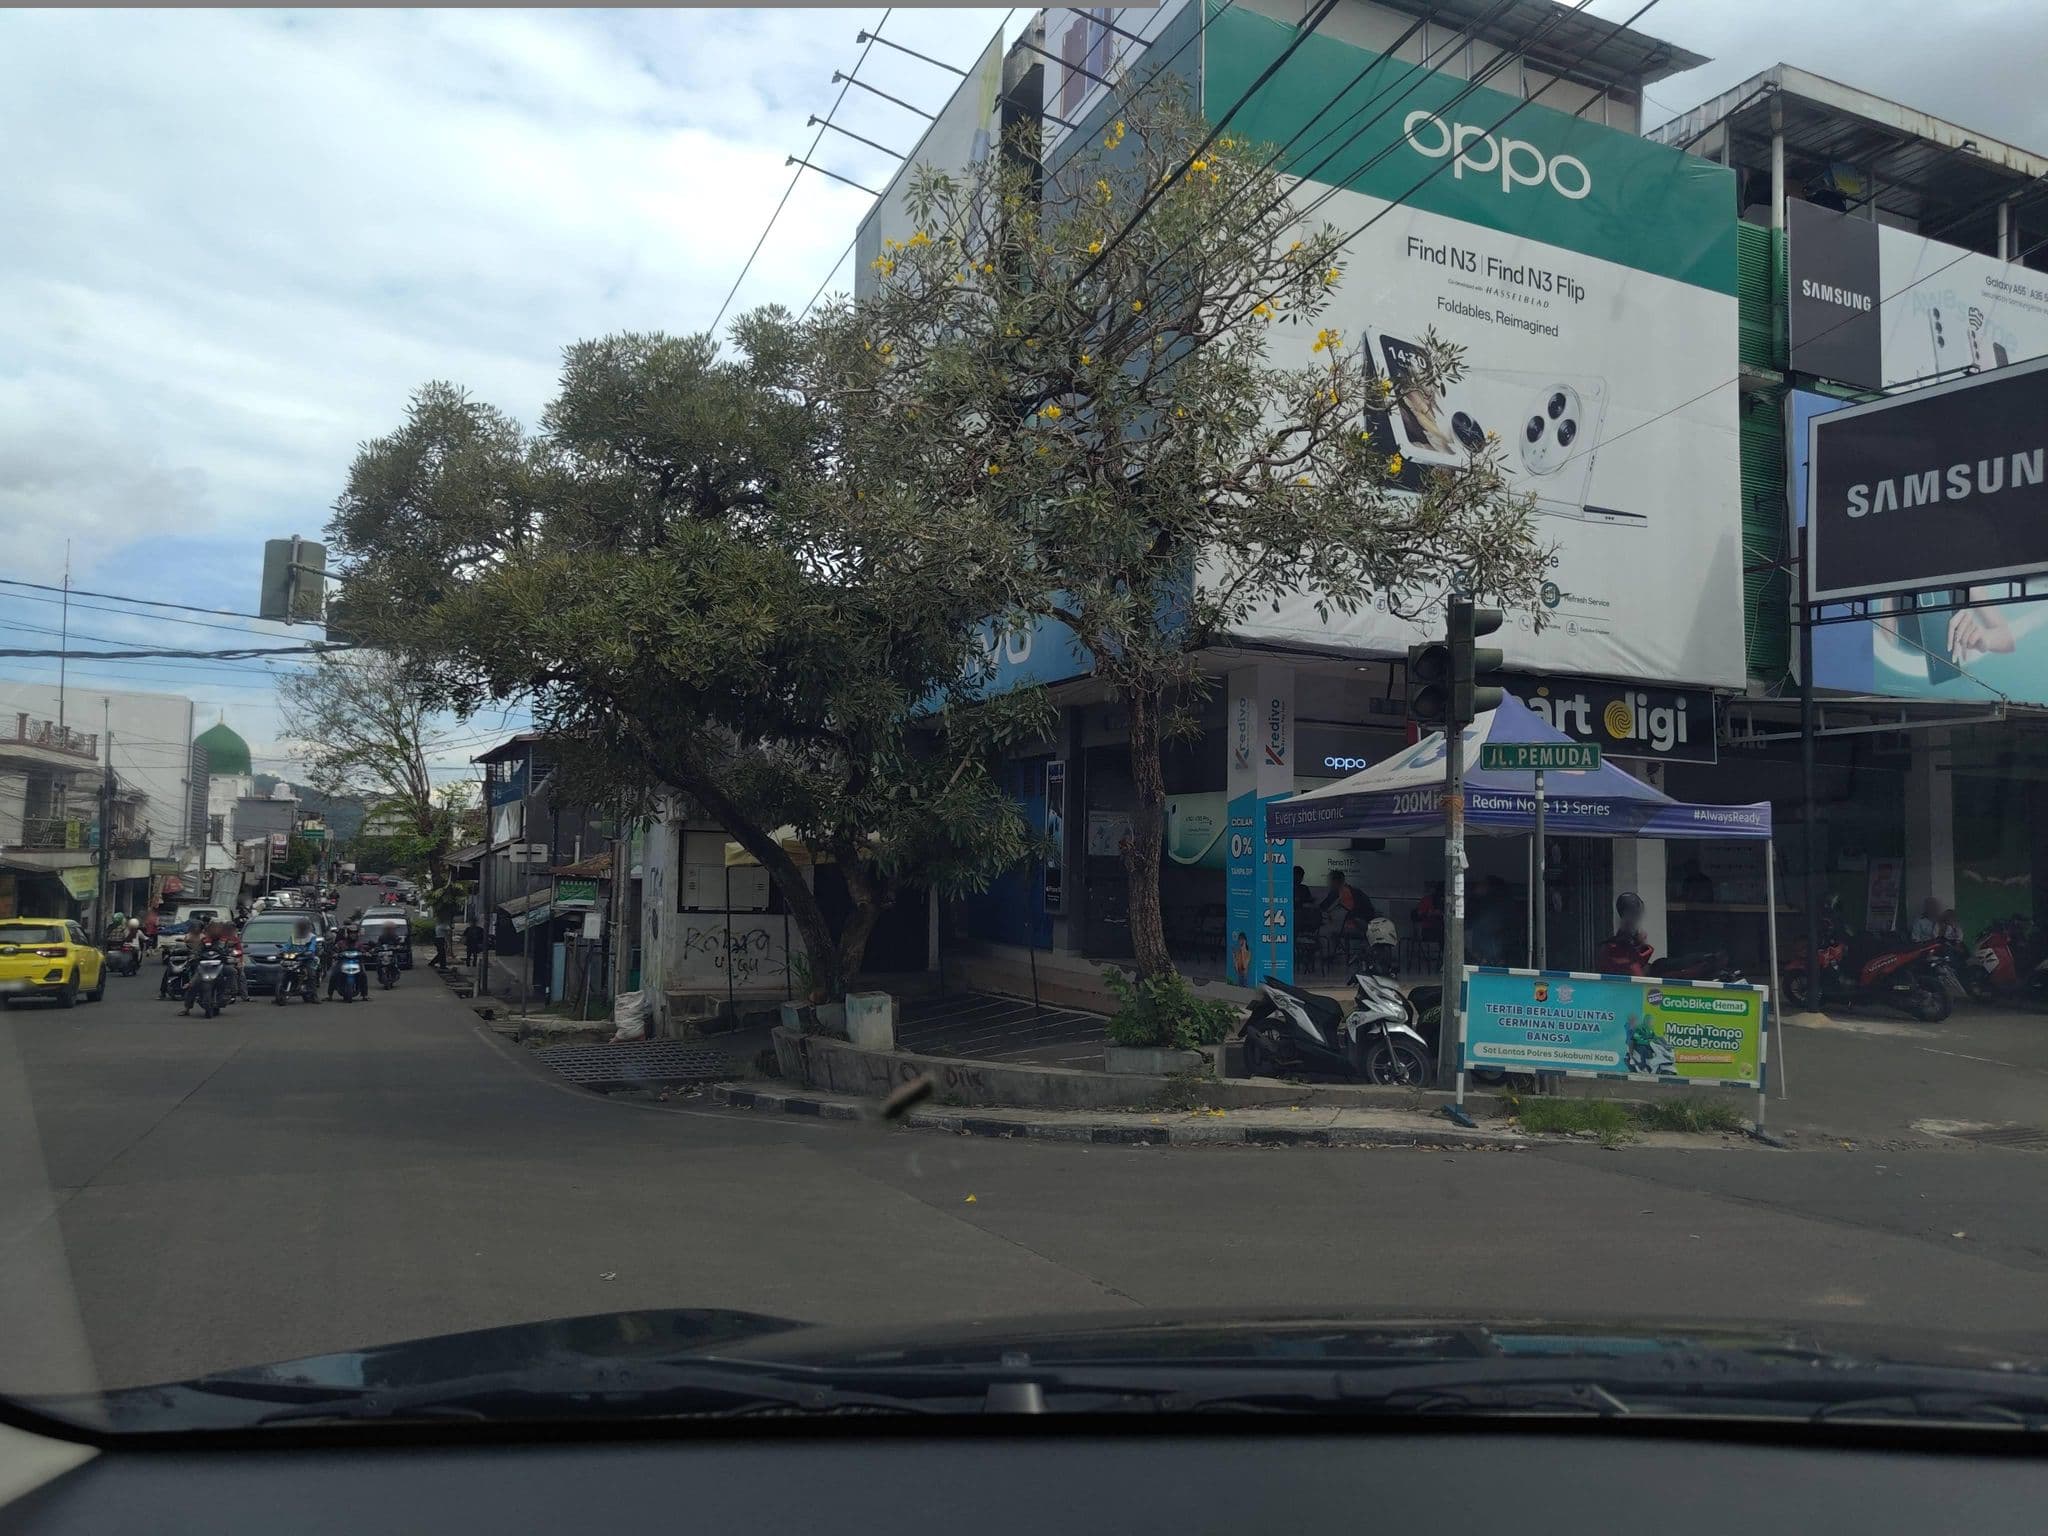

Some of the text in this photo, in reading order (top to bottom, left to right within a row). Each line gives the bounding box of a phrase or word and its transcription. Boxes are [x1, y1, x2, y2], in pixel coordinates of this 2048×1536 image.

[1402, 109, 1592, 200] oppo
[1408, 236, 1586, 304] Find N3 Find N3 Flip
[1985, 275, 2012, 294] Galaxy
[1485, 286, 1551, 309] HASSELBLAD
[1802, 279, 1873, 313] SAMSUNG
[1437, 296, 1559, 338] Foldables, Reimagined
[1846, 449, 2048, 518] SAMSUN
[1587, 598, 1611, 608] Service
[1604, 690, 1688, 752] digi
[1235, 697, 1250, 770] Kredivo
[1265, 698, 1285, 767] Kredivo
[1324, 756, 1367, 771] oppo
[1490, 746, 1593, 767] JL. PEMUDA
[1472, 794, 1610, 816] Redmi Noe 13 Series
[1275, 810, 1297, 829] Every
[1297, 807, 1317, 822] shot
[1693, 809, 1761, 826] #AlwaysReady
[1231, 833, 1253, 858] 0%
[1485, 1003, 1615, 1021] TERTIB BERLALU LINTAS
[1662, 997, 1744, 1011] GrabBike Hemat
[1498, 1017, 1600, 1032] CERMINAN BUDAYA
[1666, 1024, 1743, 1041] Murah Tanpa
[1526, 1032, 1571, 1043] BANGSA
[1669, 1036, 1740, 1051] Kode Promo
[1482, 1046, 1614, 1063] Sat Lantas Polres Sukabumi Kota
